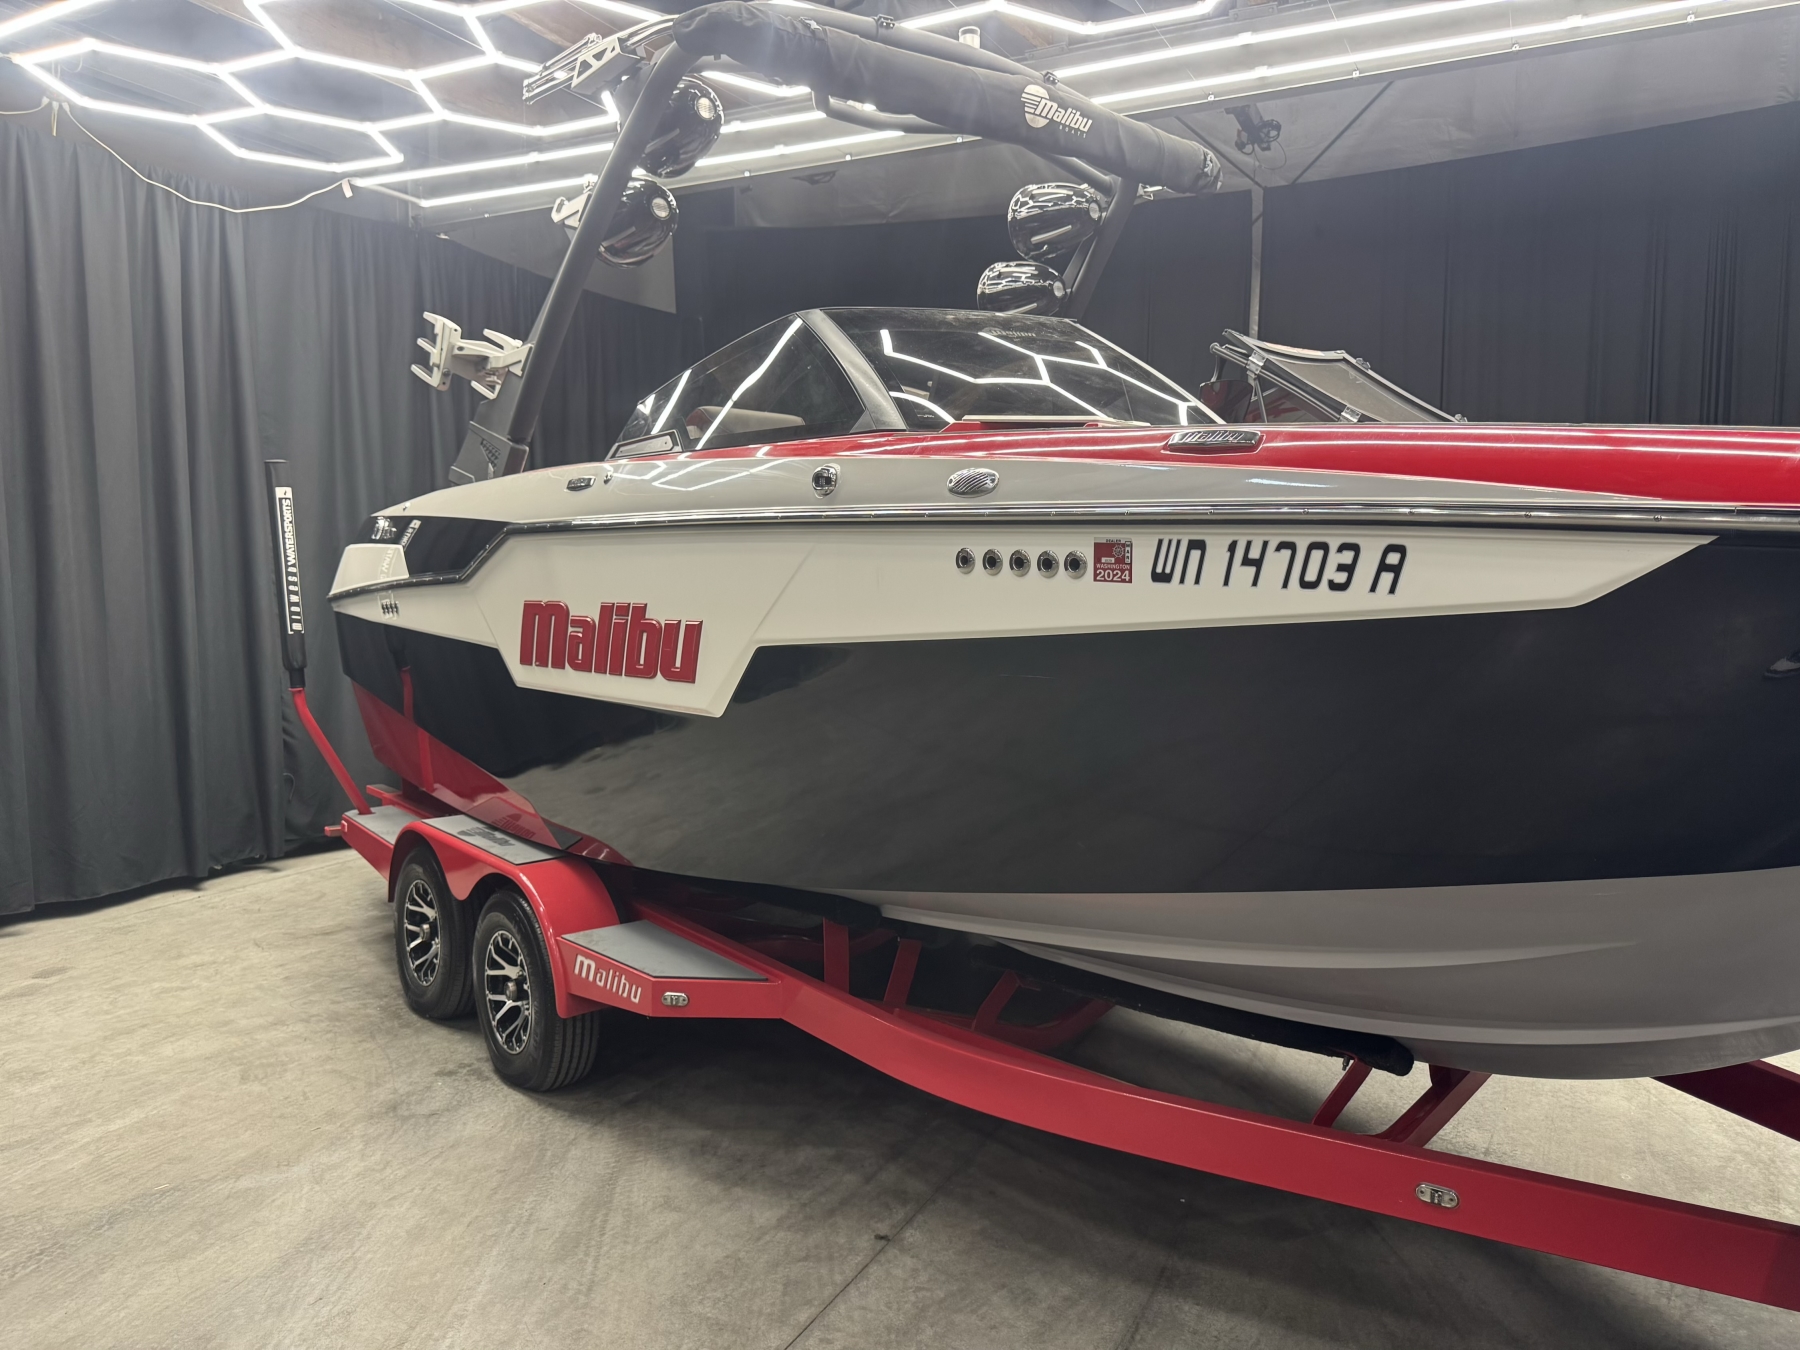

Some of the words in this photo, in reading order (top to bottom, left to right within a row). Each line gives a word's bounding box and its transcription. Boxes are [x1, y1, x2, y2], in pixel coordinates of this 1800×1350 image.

[1034, 98, 1093, 132] Malibu
[1059, 125, 1087, 138] BOATS
[283, 498, 296, 566] WATERSPORTS
[1096, 569, 1130, 581] 2024
[1150, 538, 1207, 585] WN
[1222, 539, 1361, 592] 14703
[1367, 543, 1407, 595] A
[519, 600, 704, 684] Malibu
[574, 953, 642, 1004] Malibu
